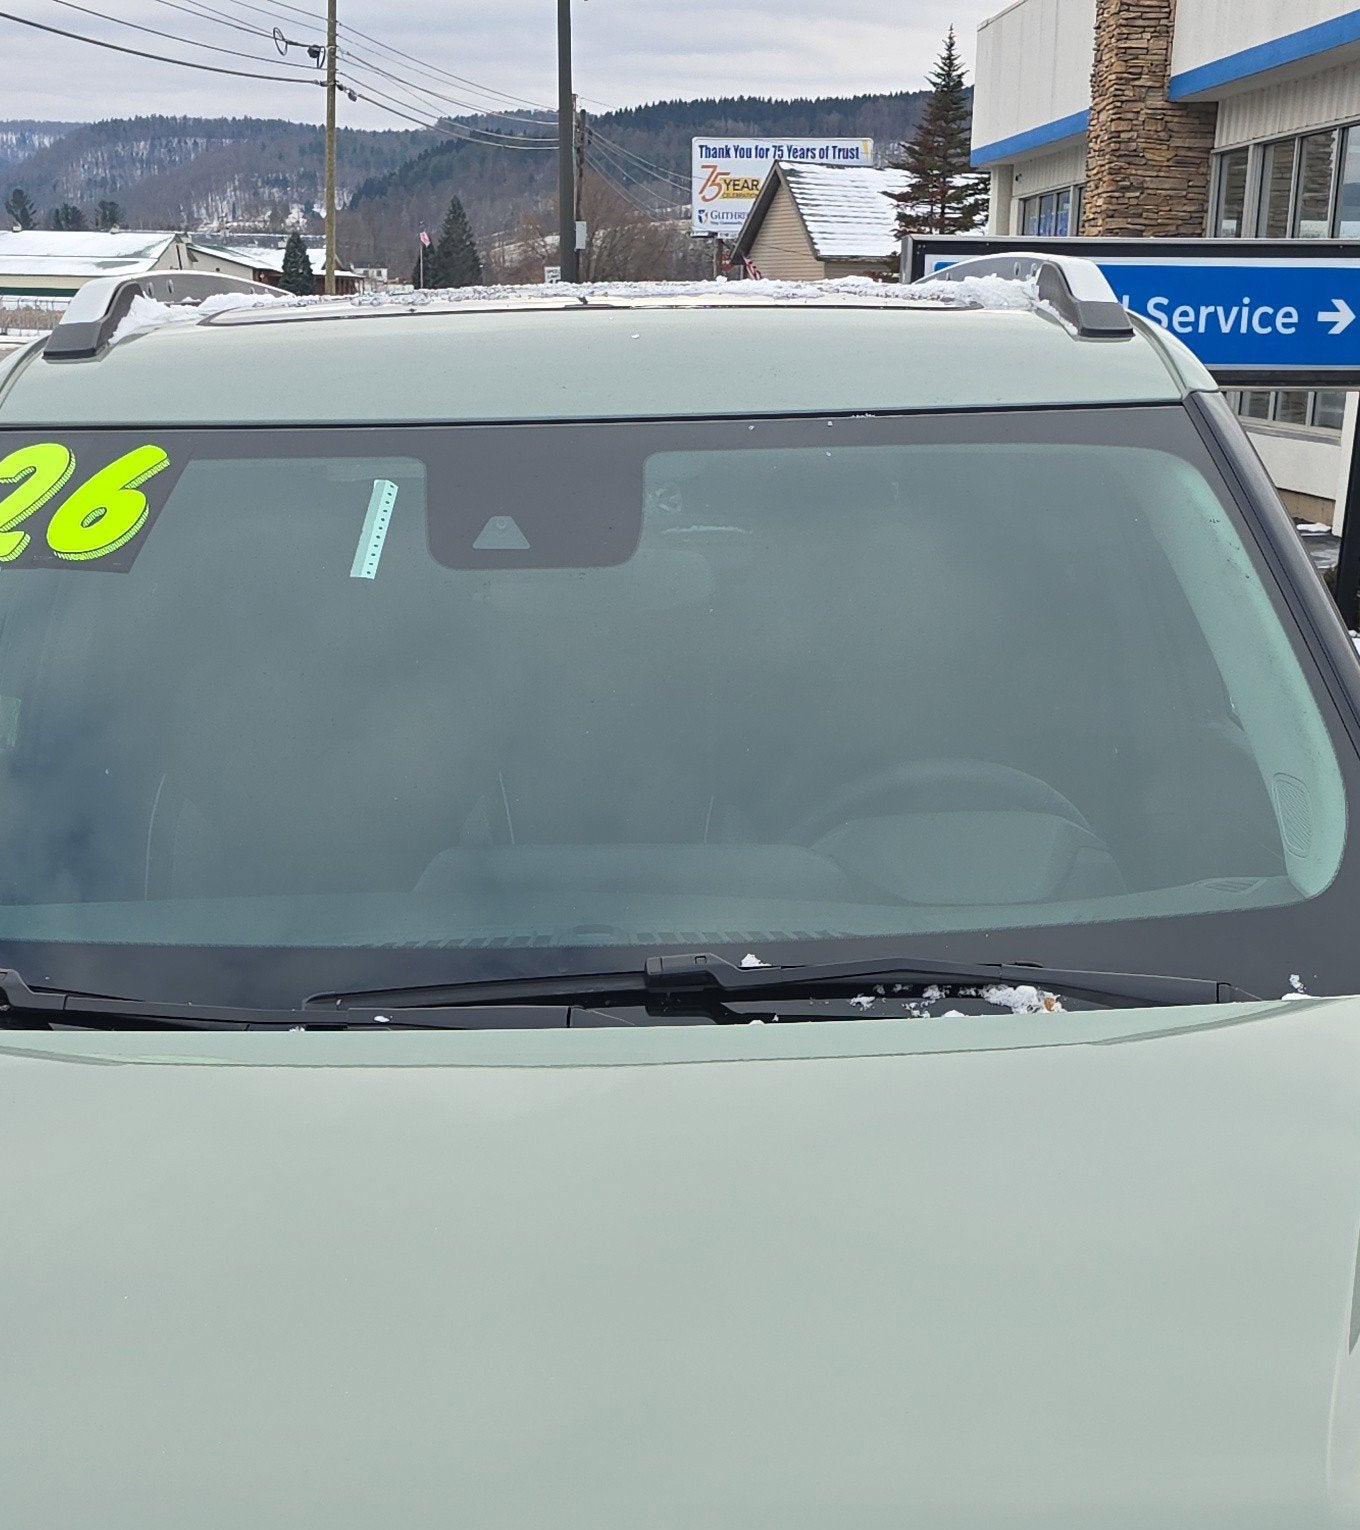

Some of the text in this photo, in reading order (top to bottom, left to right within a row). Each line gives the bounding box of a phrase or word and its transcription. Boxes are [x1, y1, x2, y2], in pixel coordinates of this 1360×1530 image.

[698, 144, 859, 160] Thank You for 75 Years of Trust
[698, 165, 760, 202] 75 YEAR
[1145, 295, 1299, 335] Service
